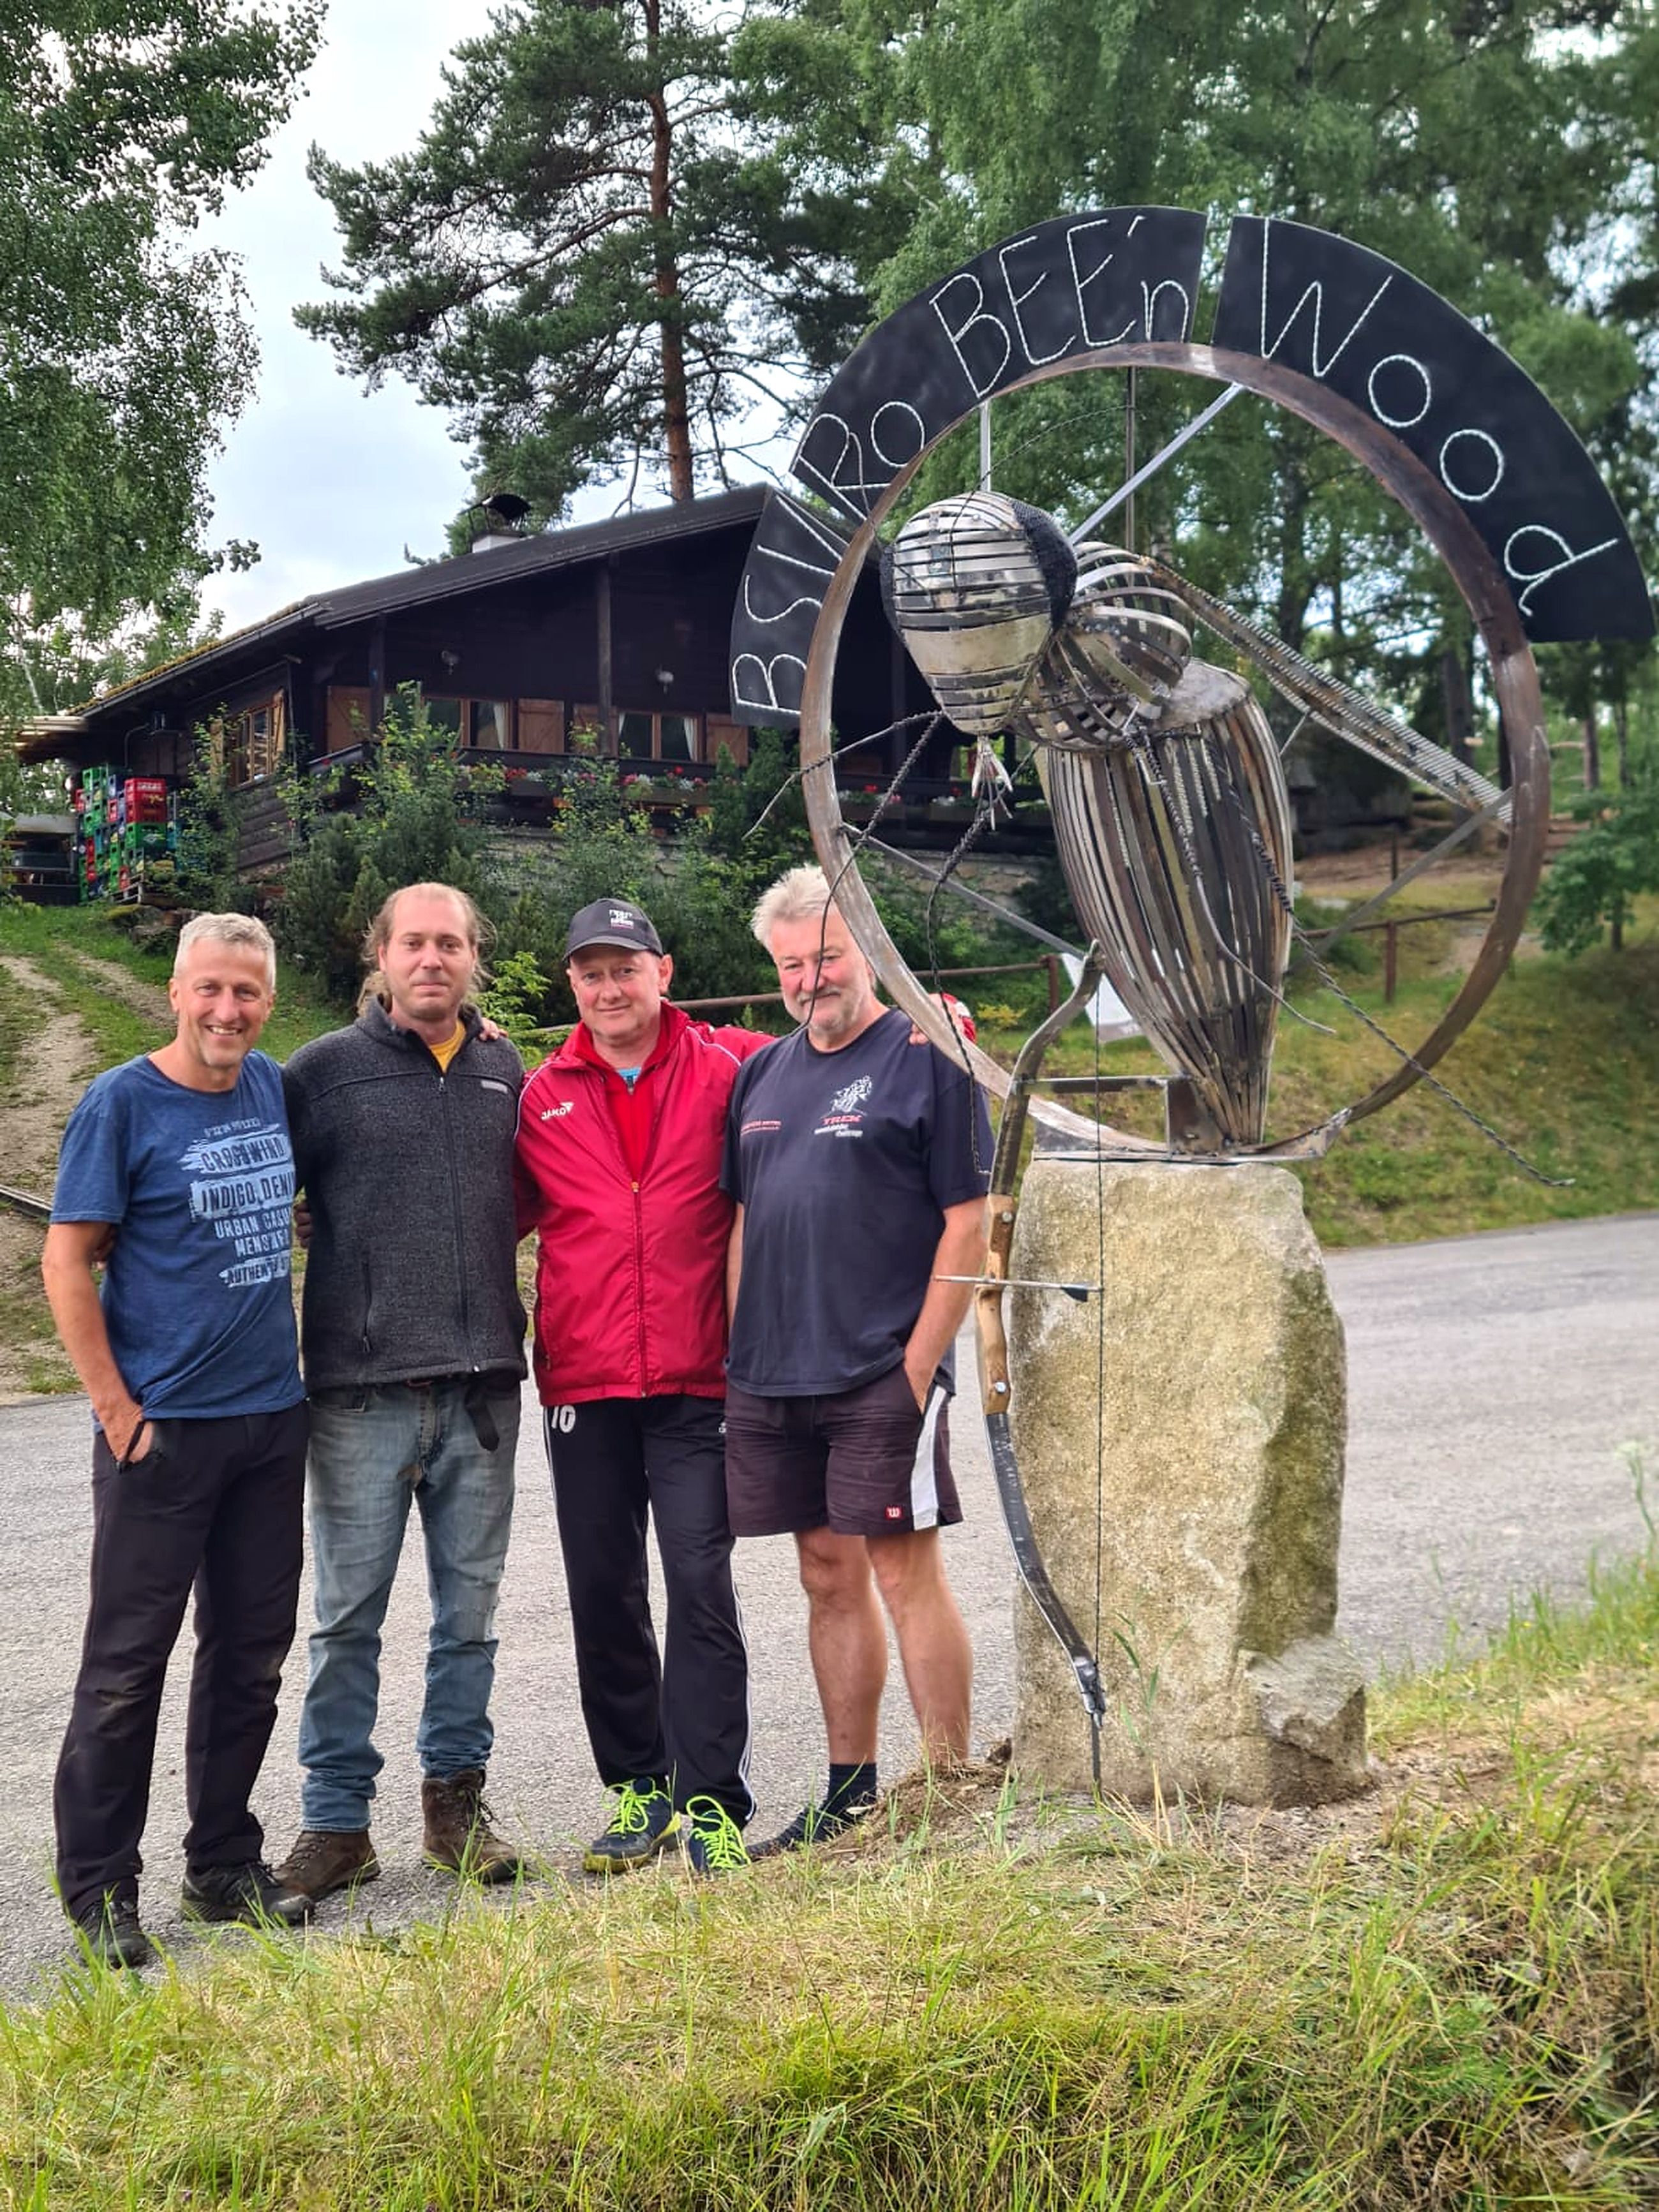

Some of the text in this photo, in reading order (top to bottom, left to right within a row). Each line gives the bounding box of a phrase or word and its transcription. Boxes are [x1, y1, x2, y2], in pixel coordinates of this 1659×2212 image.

[540, 1106, 567, 1121] JAKO
[214, 1215, 259, 1239] URBAN
[551, 1404, 576, 1434] 10
